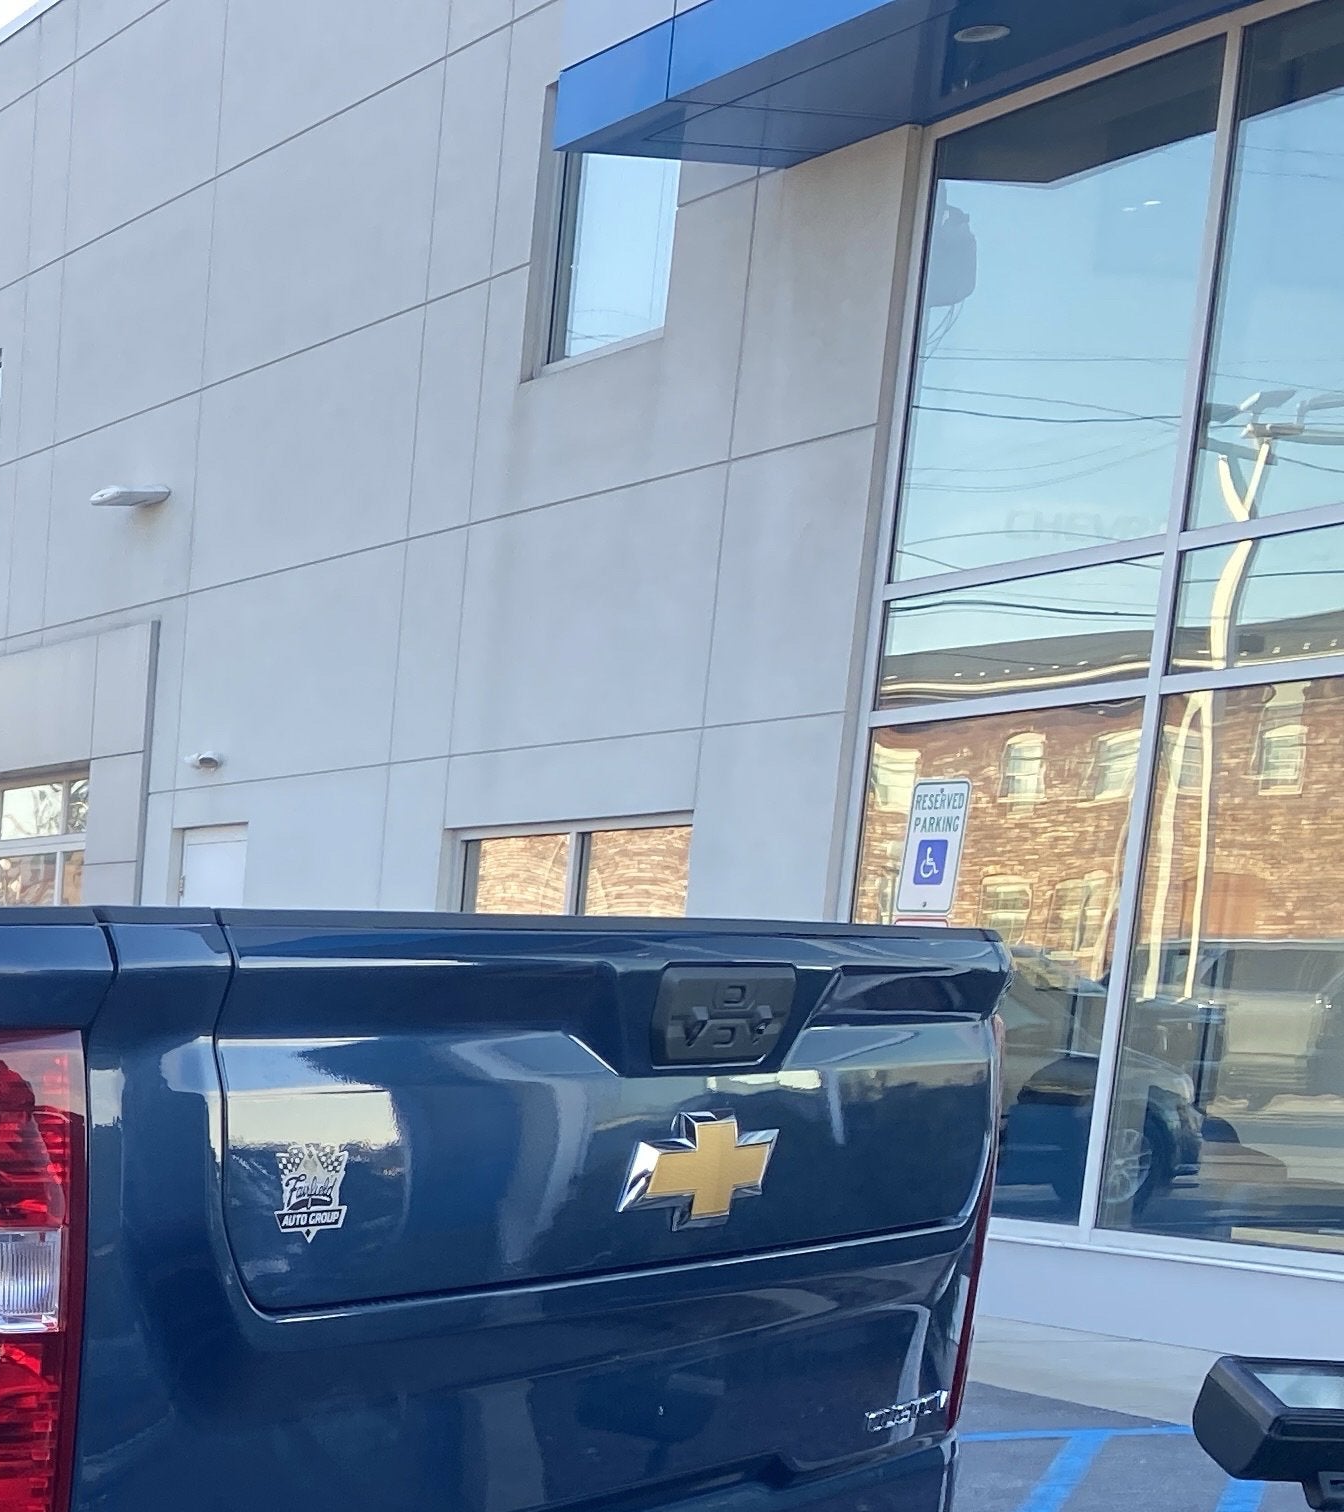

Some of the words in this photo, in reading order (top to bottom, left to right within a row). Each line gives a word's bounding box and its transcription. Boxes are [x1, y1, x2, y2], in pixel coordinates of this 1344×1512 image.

[915, 793, 965, 810] RESERVED
[914, 815, 960, 833] PARKING
[282, 1213, 307, 1227] AUTO
[309, 1211, 339, 1225] GROUP
